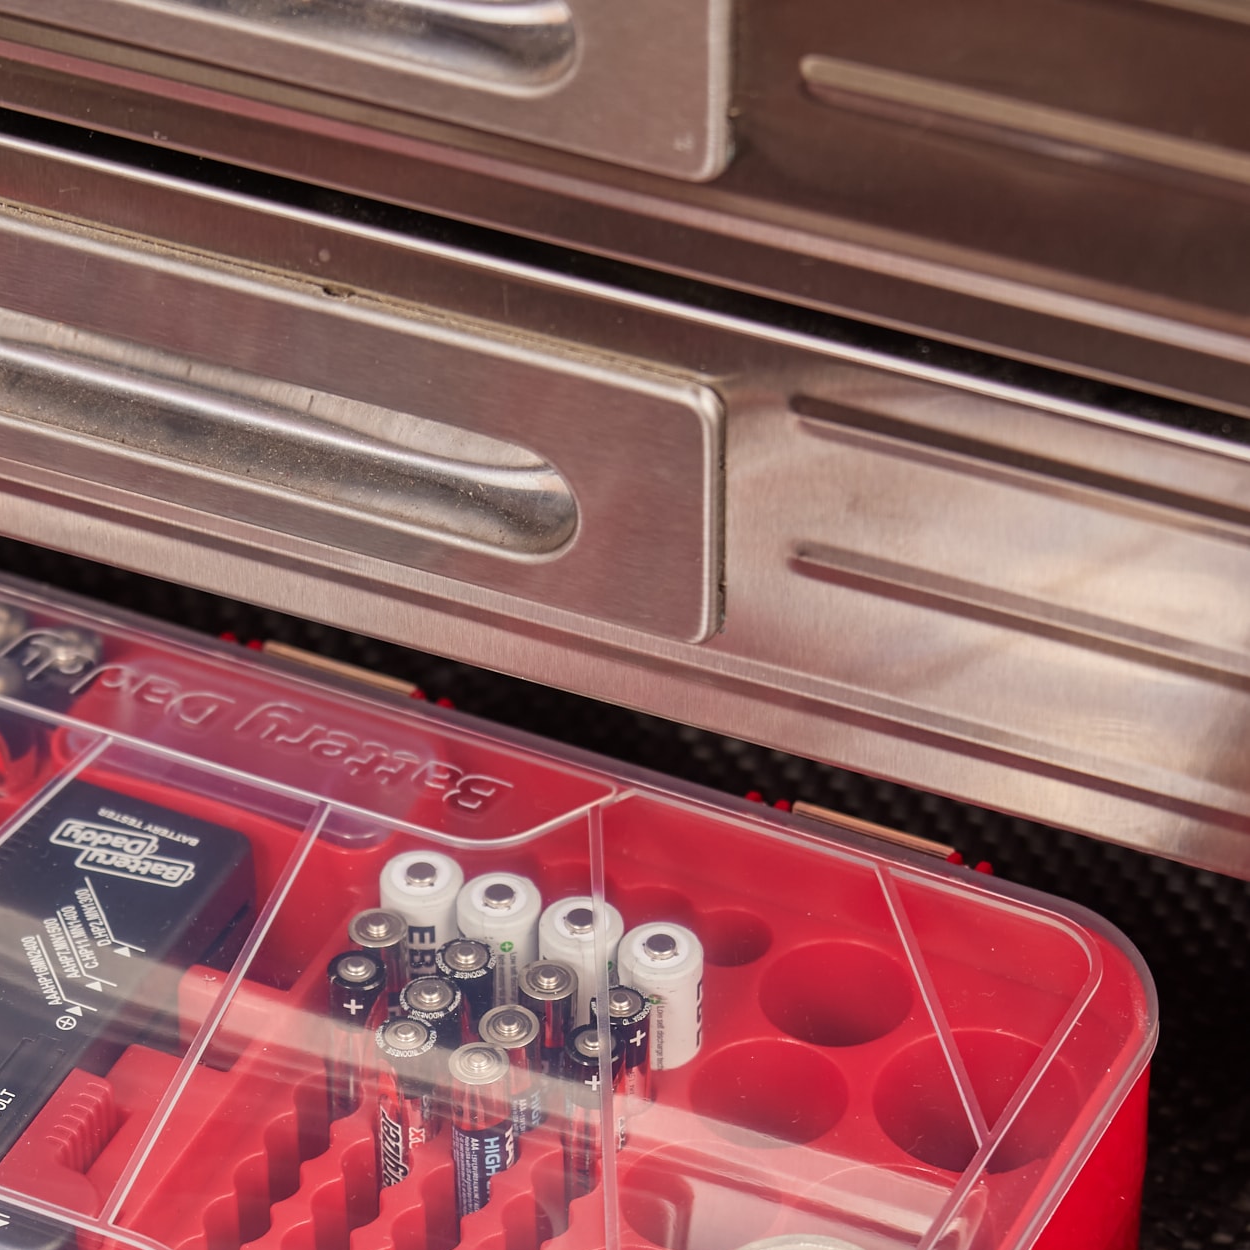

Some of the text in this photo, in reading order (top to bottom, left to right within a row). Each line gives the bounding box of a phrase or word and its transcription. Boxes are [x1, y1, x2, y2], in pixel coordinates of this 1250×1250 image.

[232, 699, 514, 811] Battery
[60, 822, 149, 855] Daddy
[97, 806, 200, 847] BATTERY TESTER
[86, 848, 187, 884] Battery
[408, 925, 436, 978] EB
[470, 1137, 479, 1150] AAA
[484, 1136, 501, 1176] HIGH
